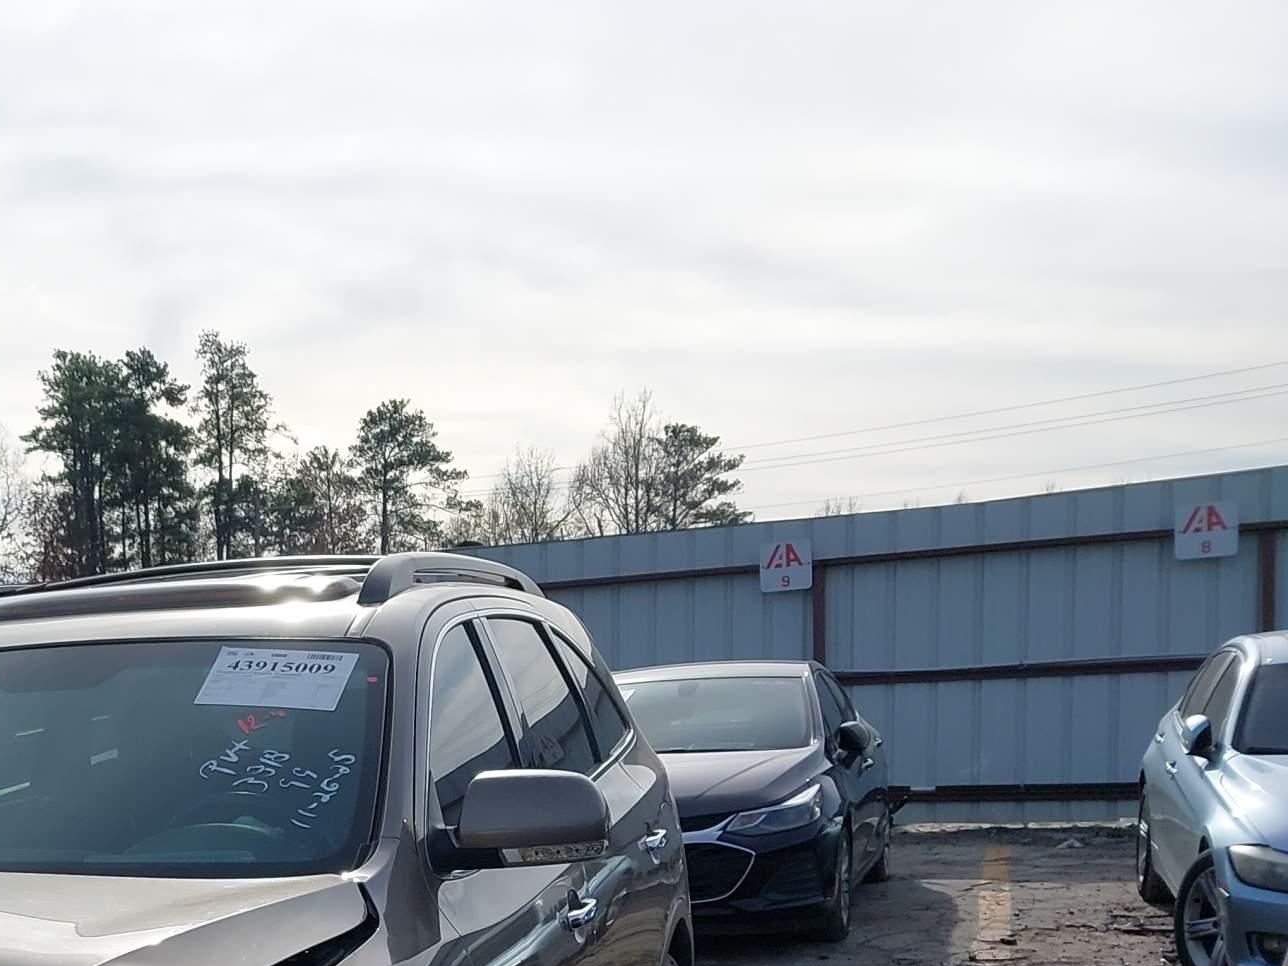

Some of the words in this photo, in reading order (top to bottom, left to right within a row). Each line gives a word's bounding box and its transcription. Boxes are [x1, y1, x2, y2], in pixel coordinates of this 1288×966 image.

[1201, 541, 1212, 554] 8
[782, 575, 791, 587] 9
[227, 660, 336, 675] 43915009
